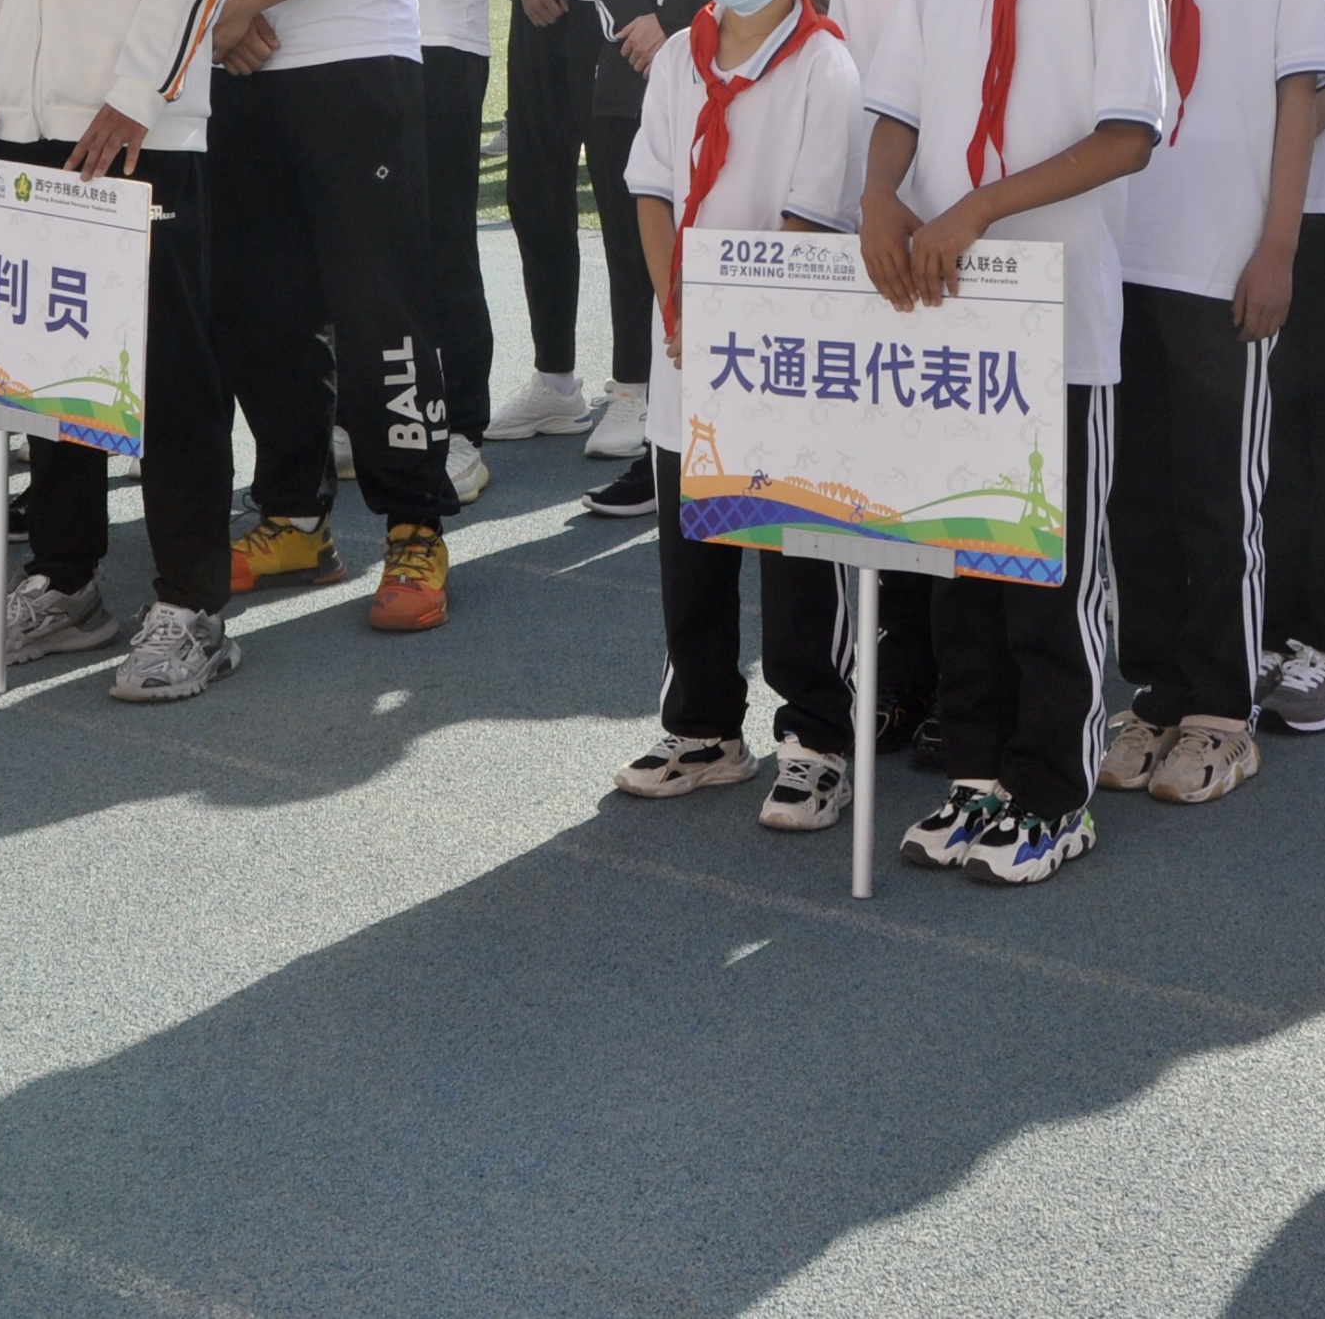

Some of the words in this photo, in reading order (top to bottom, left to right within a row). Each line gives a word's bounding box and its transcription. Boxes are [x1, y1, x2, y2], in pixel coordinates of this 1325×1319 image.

[34, 178, 118, 205] 西宁市残疾人联合会
[720, 239, 785, 264] 2022
[382, 336, 428, 450] BALL
[709, 331, 1030, 416] 大通县代表队
